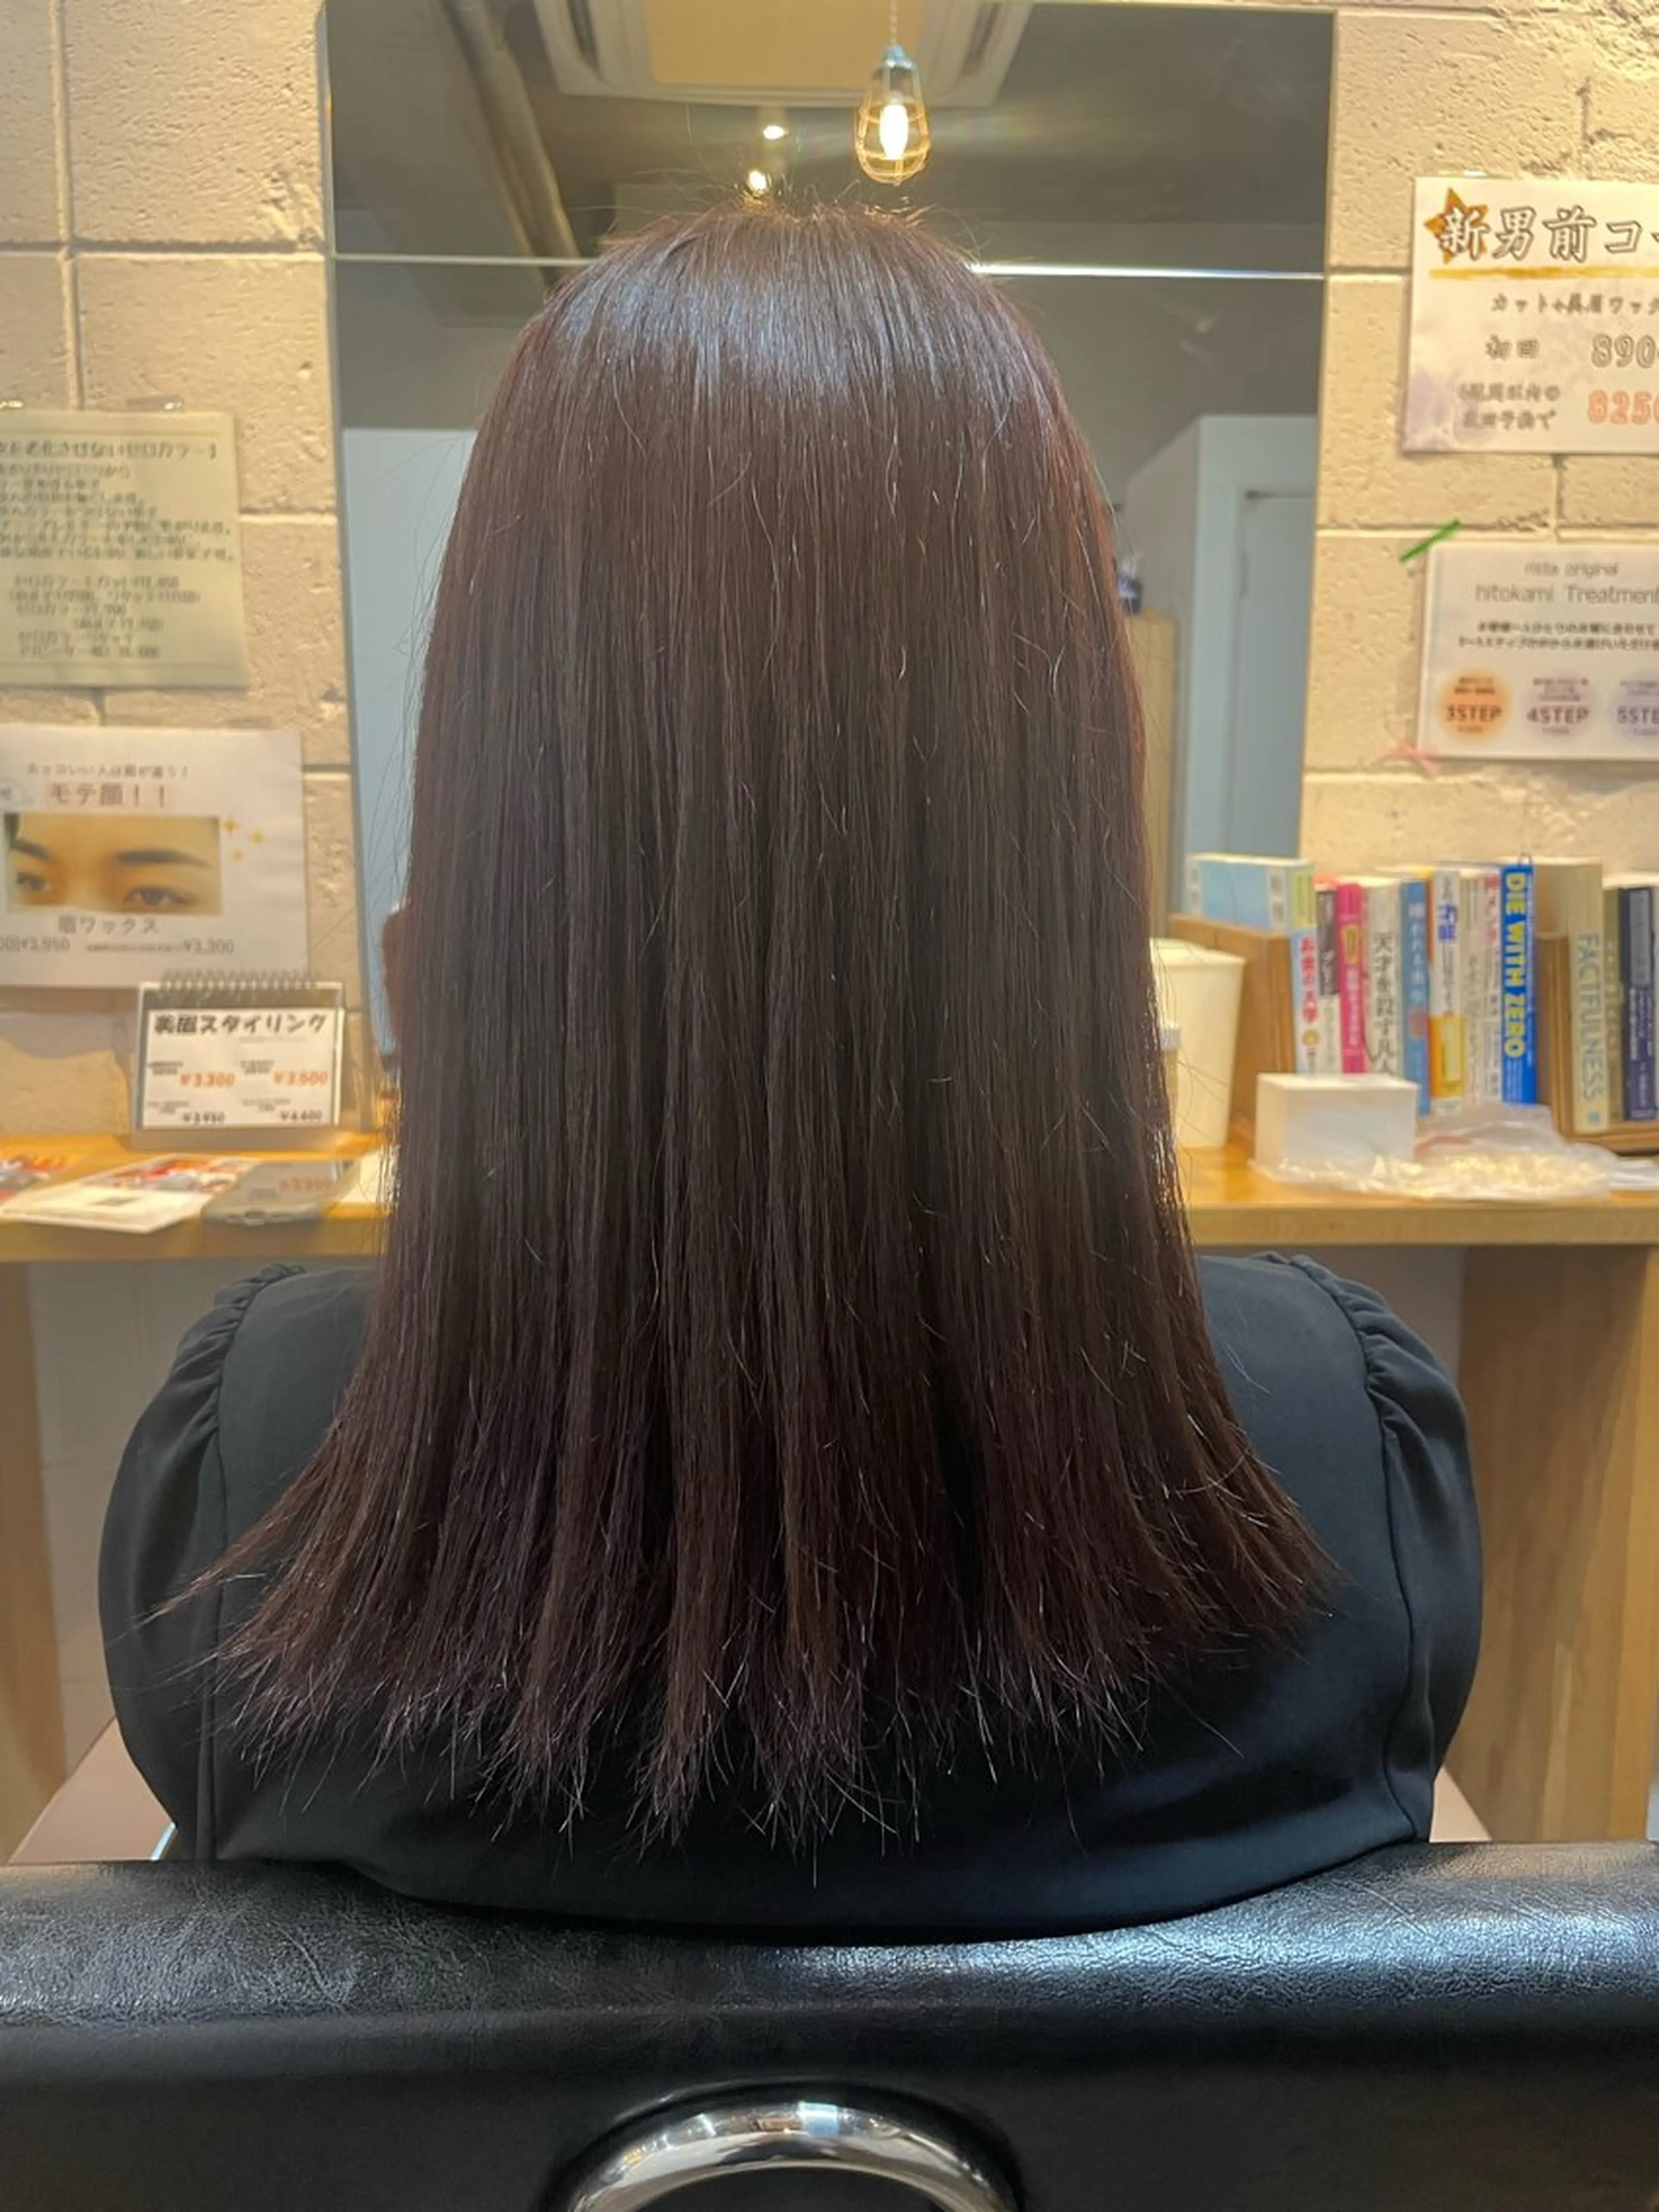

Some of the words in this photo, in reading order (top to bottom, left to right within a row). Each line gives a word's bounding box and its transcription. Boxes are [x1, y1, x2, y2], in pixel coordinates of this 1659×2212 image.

[1438, 204, 1659, 264] 新男前コ
[1591, 333, 1659, 369] 890
[1587, 390, 1659, 425] 825
[1505, 873, 1526, 915] DIE
[1505, 922, 1526, 987] WITH
[1504, 995, 1526, 1058] ZERO
[1578, 933, 1603, 1101] FACTFULNESS
